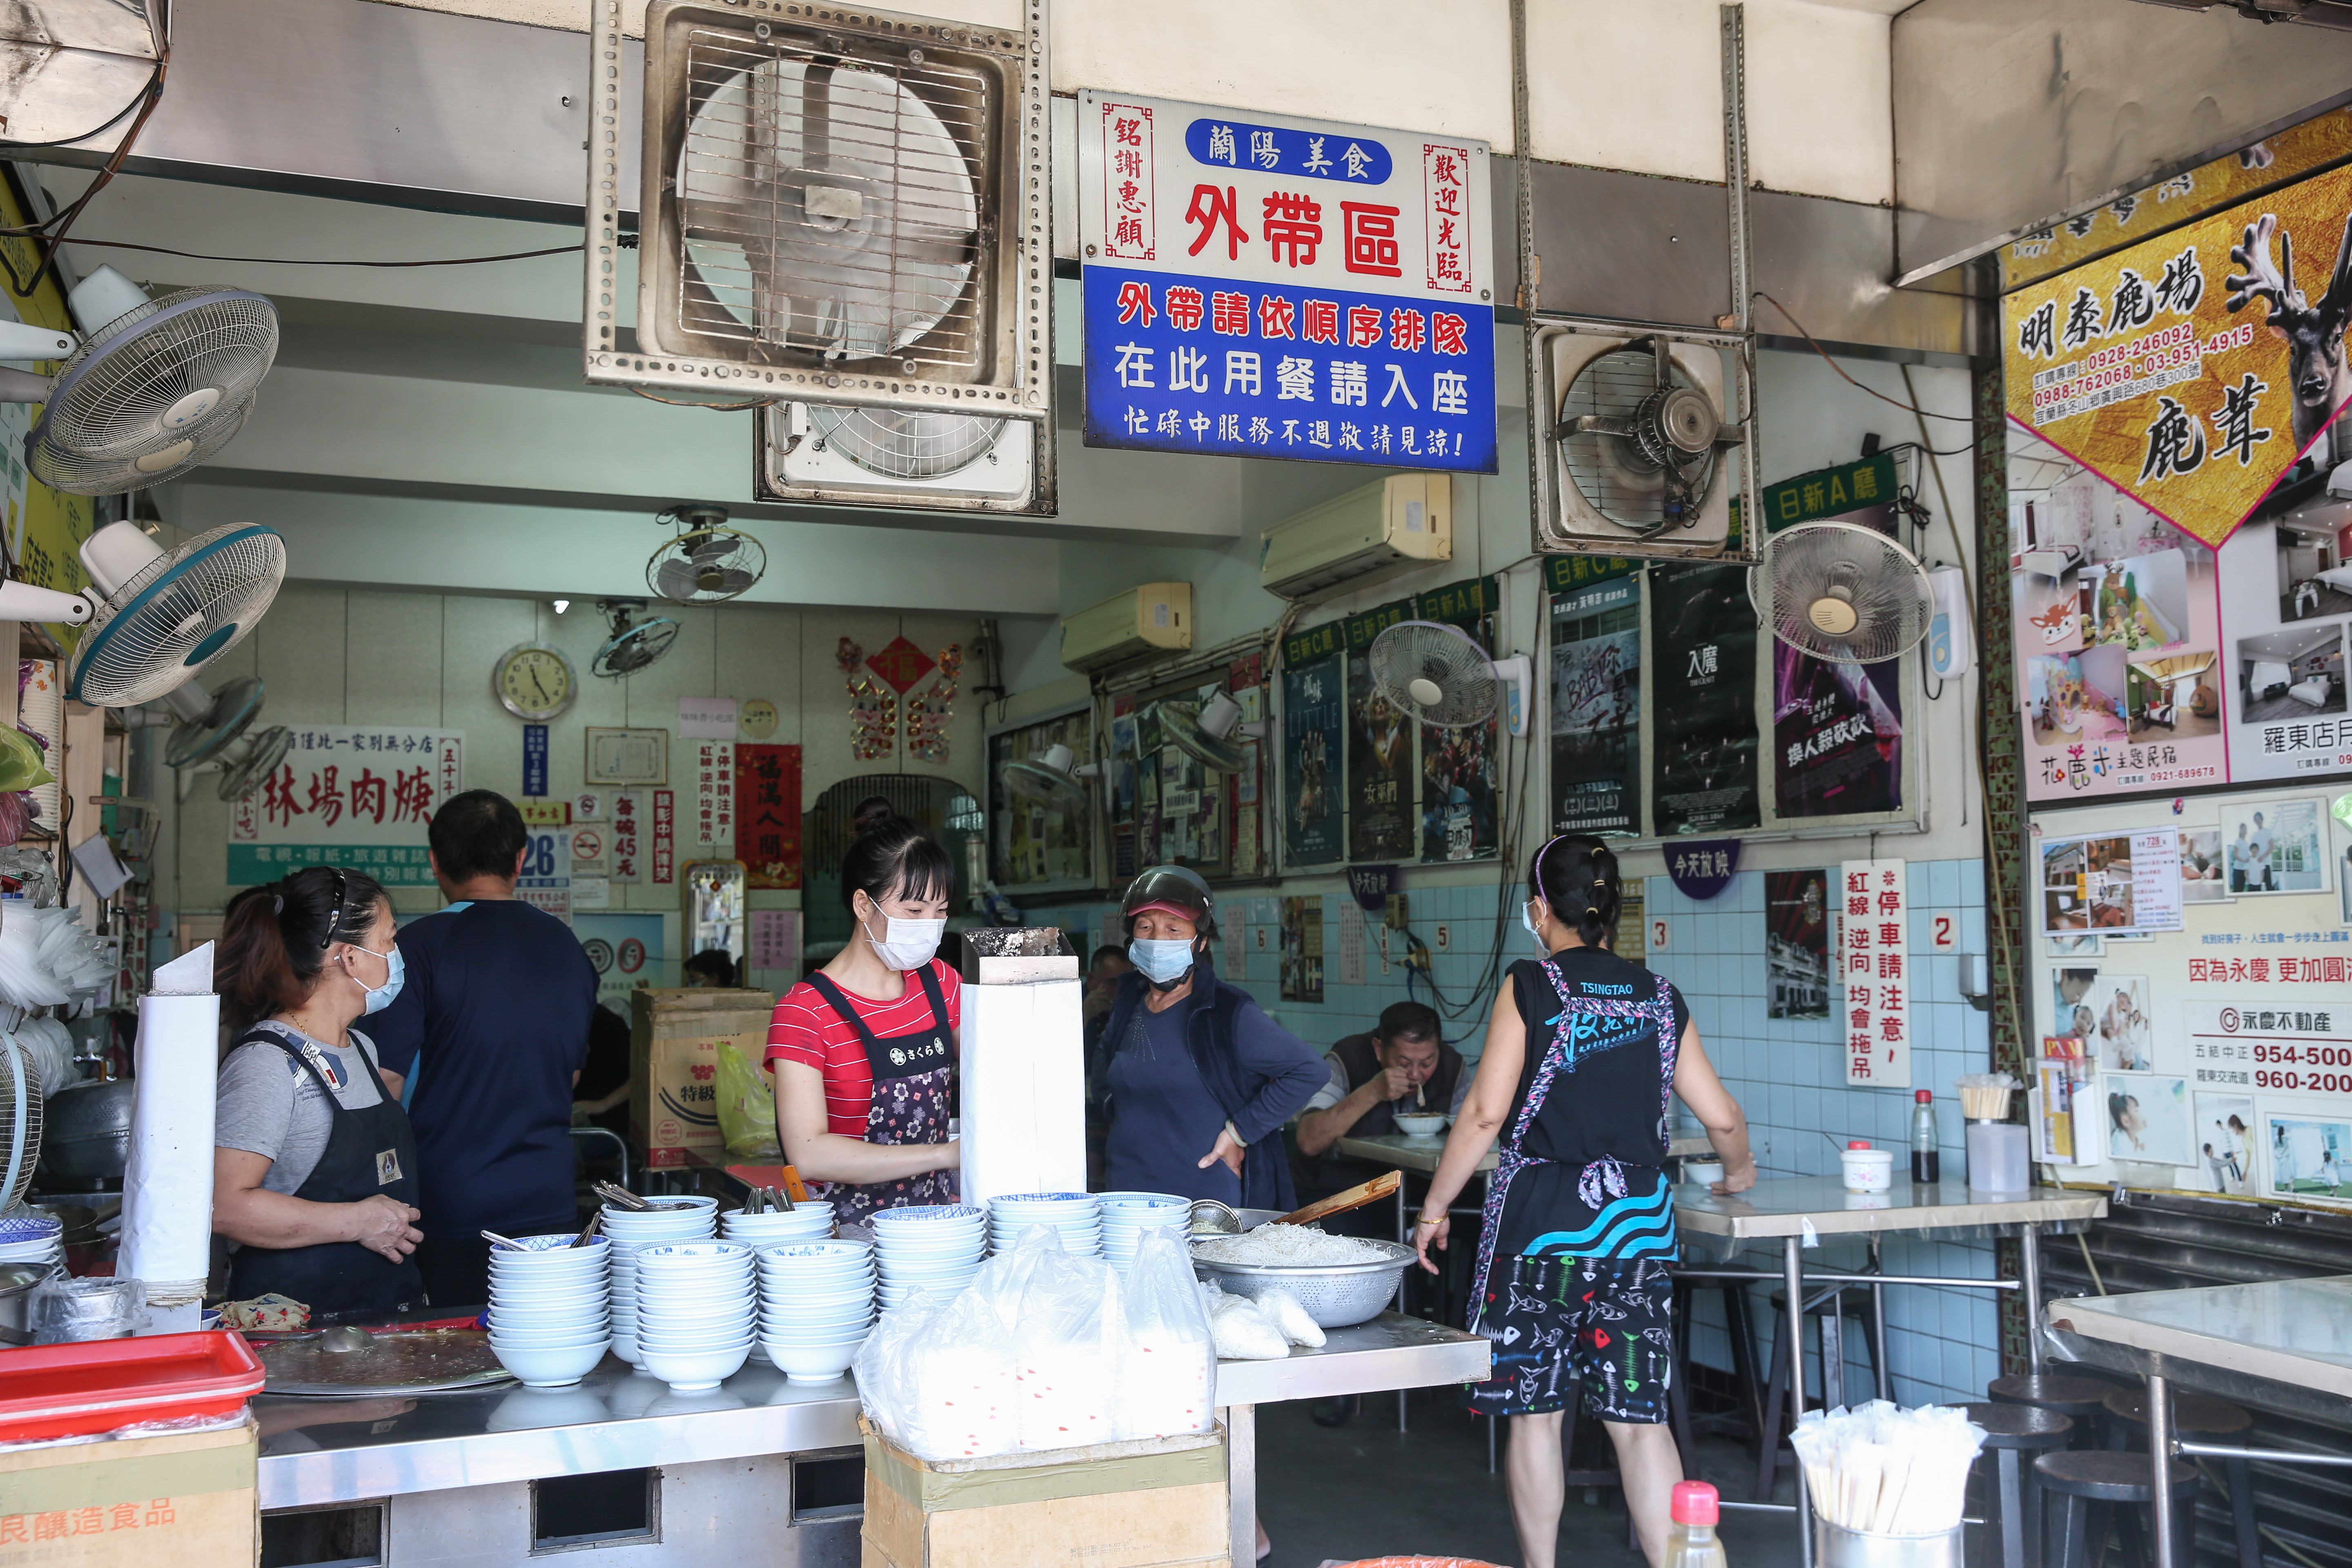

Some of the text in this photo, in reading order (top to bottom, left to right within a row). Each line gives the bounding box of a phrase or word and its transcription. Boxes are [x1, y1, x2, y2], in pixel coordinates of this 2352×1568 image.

[1209, 125, 1373, 179] 蘭陽美食
[1114, 117, 1146, 249] 銘謝惠顧
[1185, 183, 1402, 278] 外帶區
[1434, 154, 1462, 281] 歡迎光臨
[1117, 281, 1468, 356] 外帶請依順序排隊
[2020, 250, 2202, 357] 明泰鹿場
[1114, 341, 1469, 415] 在此用餐請入座
[1123, 404, 1462, 457] 忙碌中服務不週敬請見諒!
[2137, 374, 2270, 485] 鹿茸
[1780, 466, 1877, 520] 日新A廳
[879, 647, 918, 681] 福
[1289, 635, 1334, 662] 日新C廳
[1686, 645, 1718, 677] 入魔
[1288, 702, 1338, 737] LITTLE
[757, 755, 784, 859] 福滿人間
[615, 797, 636, 876] 每碗45元
[1675, 850, 1730, 878] 今天放映
[1258, 930, 1264, 946] 6
[1439, 927, 1446, 946] 5
[1654, 922, 1665, 945] 3
[1935, 918, 1951, 945] 2
[1581, 982, 1633, 995] TSINGTAO
[2243, 1011, 2331, 1031] 永慶不動產
[907, 1045, 933, 1060] さくら
[2196, 1068, 2249, 1084] 羅東交流道
[681, 1085, 715, 1102] 特級
